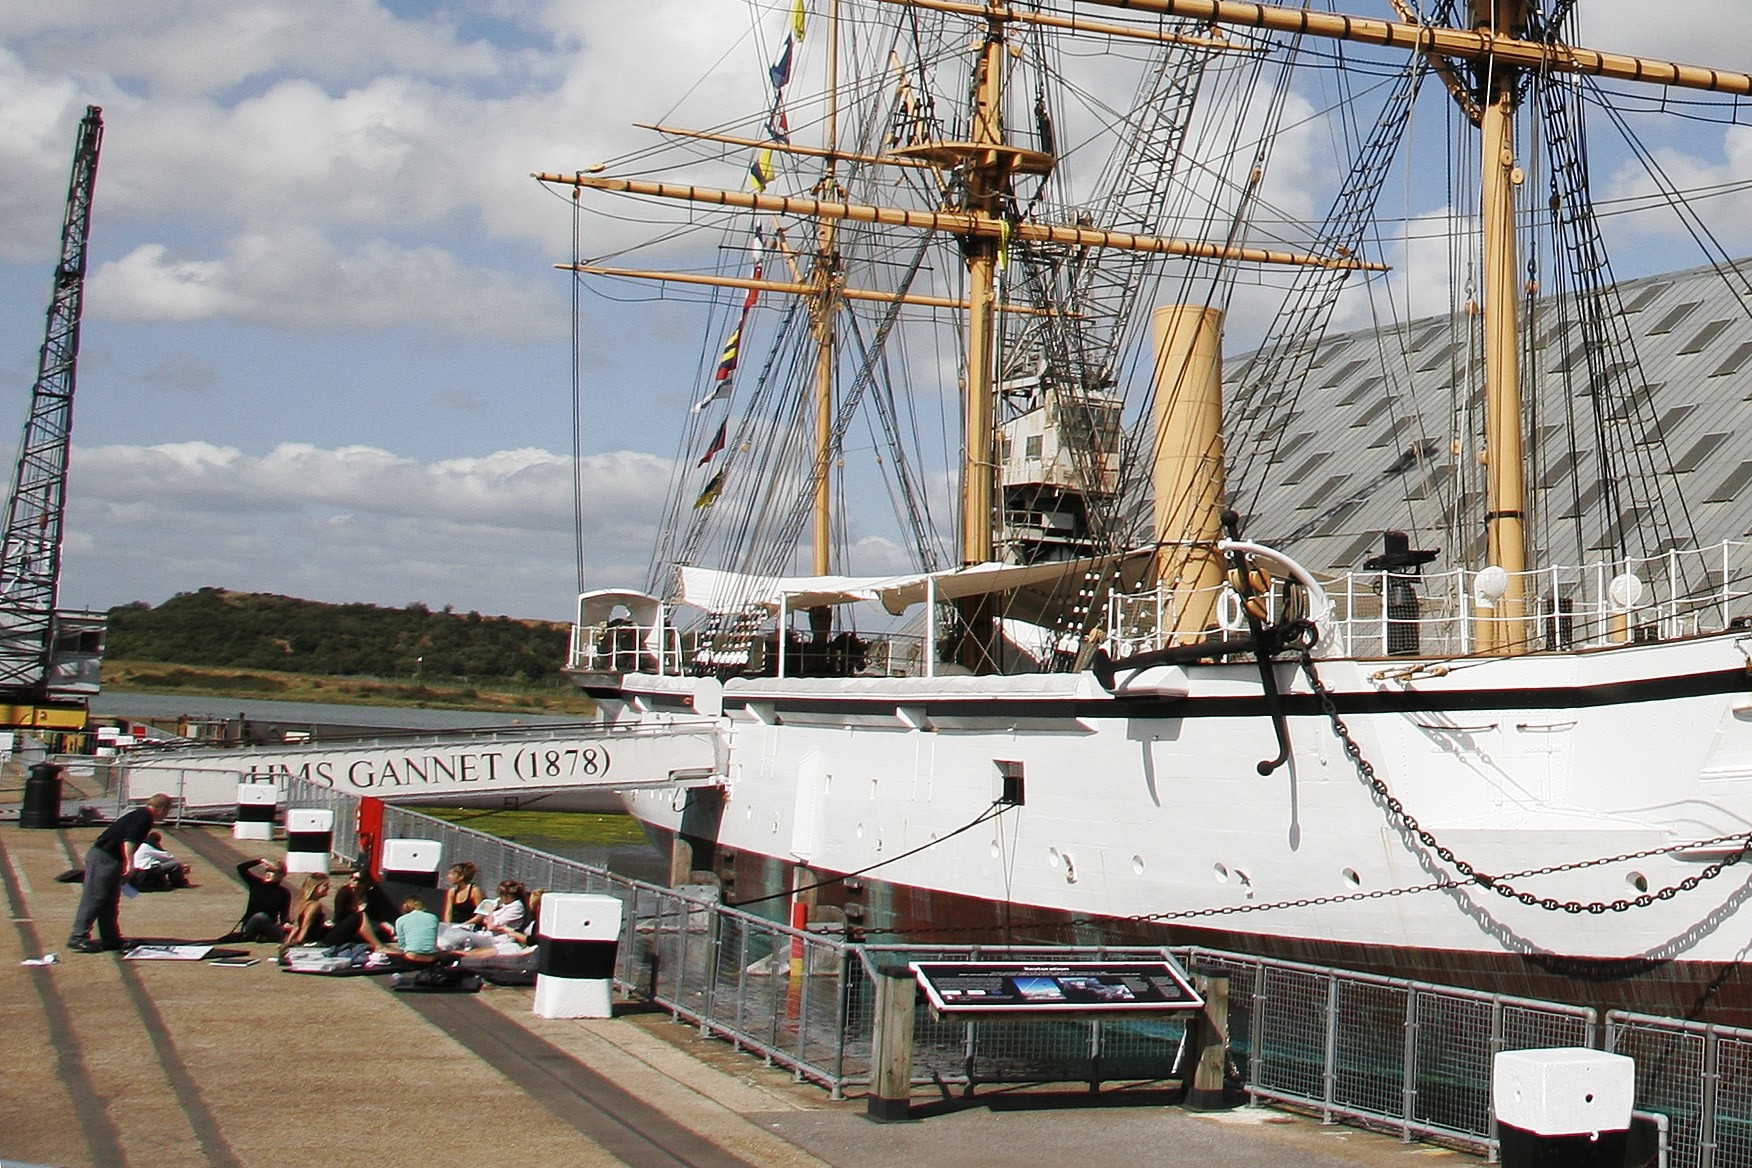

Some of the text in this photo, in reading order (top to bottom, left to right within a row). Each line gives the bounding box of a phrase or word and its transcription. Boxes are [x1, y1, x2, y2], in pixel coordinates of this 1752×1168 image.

[250, 743, 612, 792] HMS GANNET (1878)
